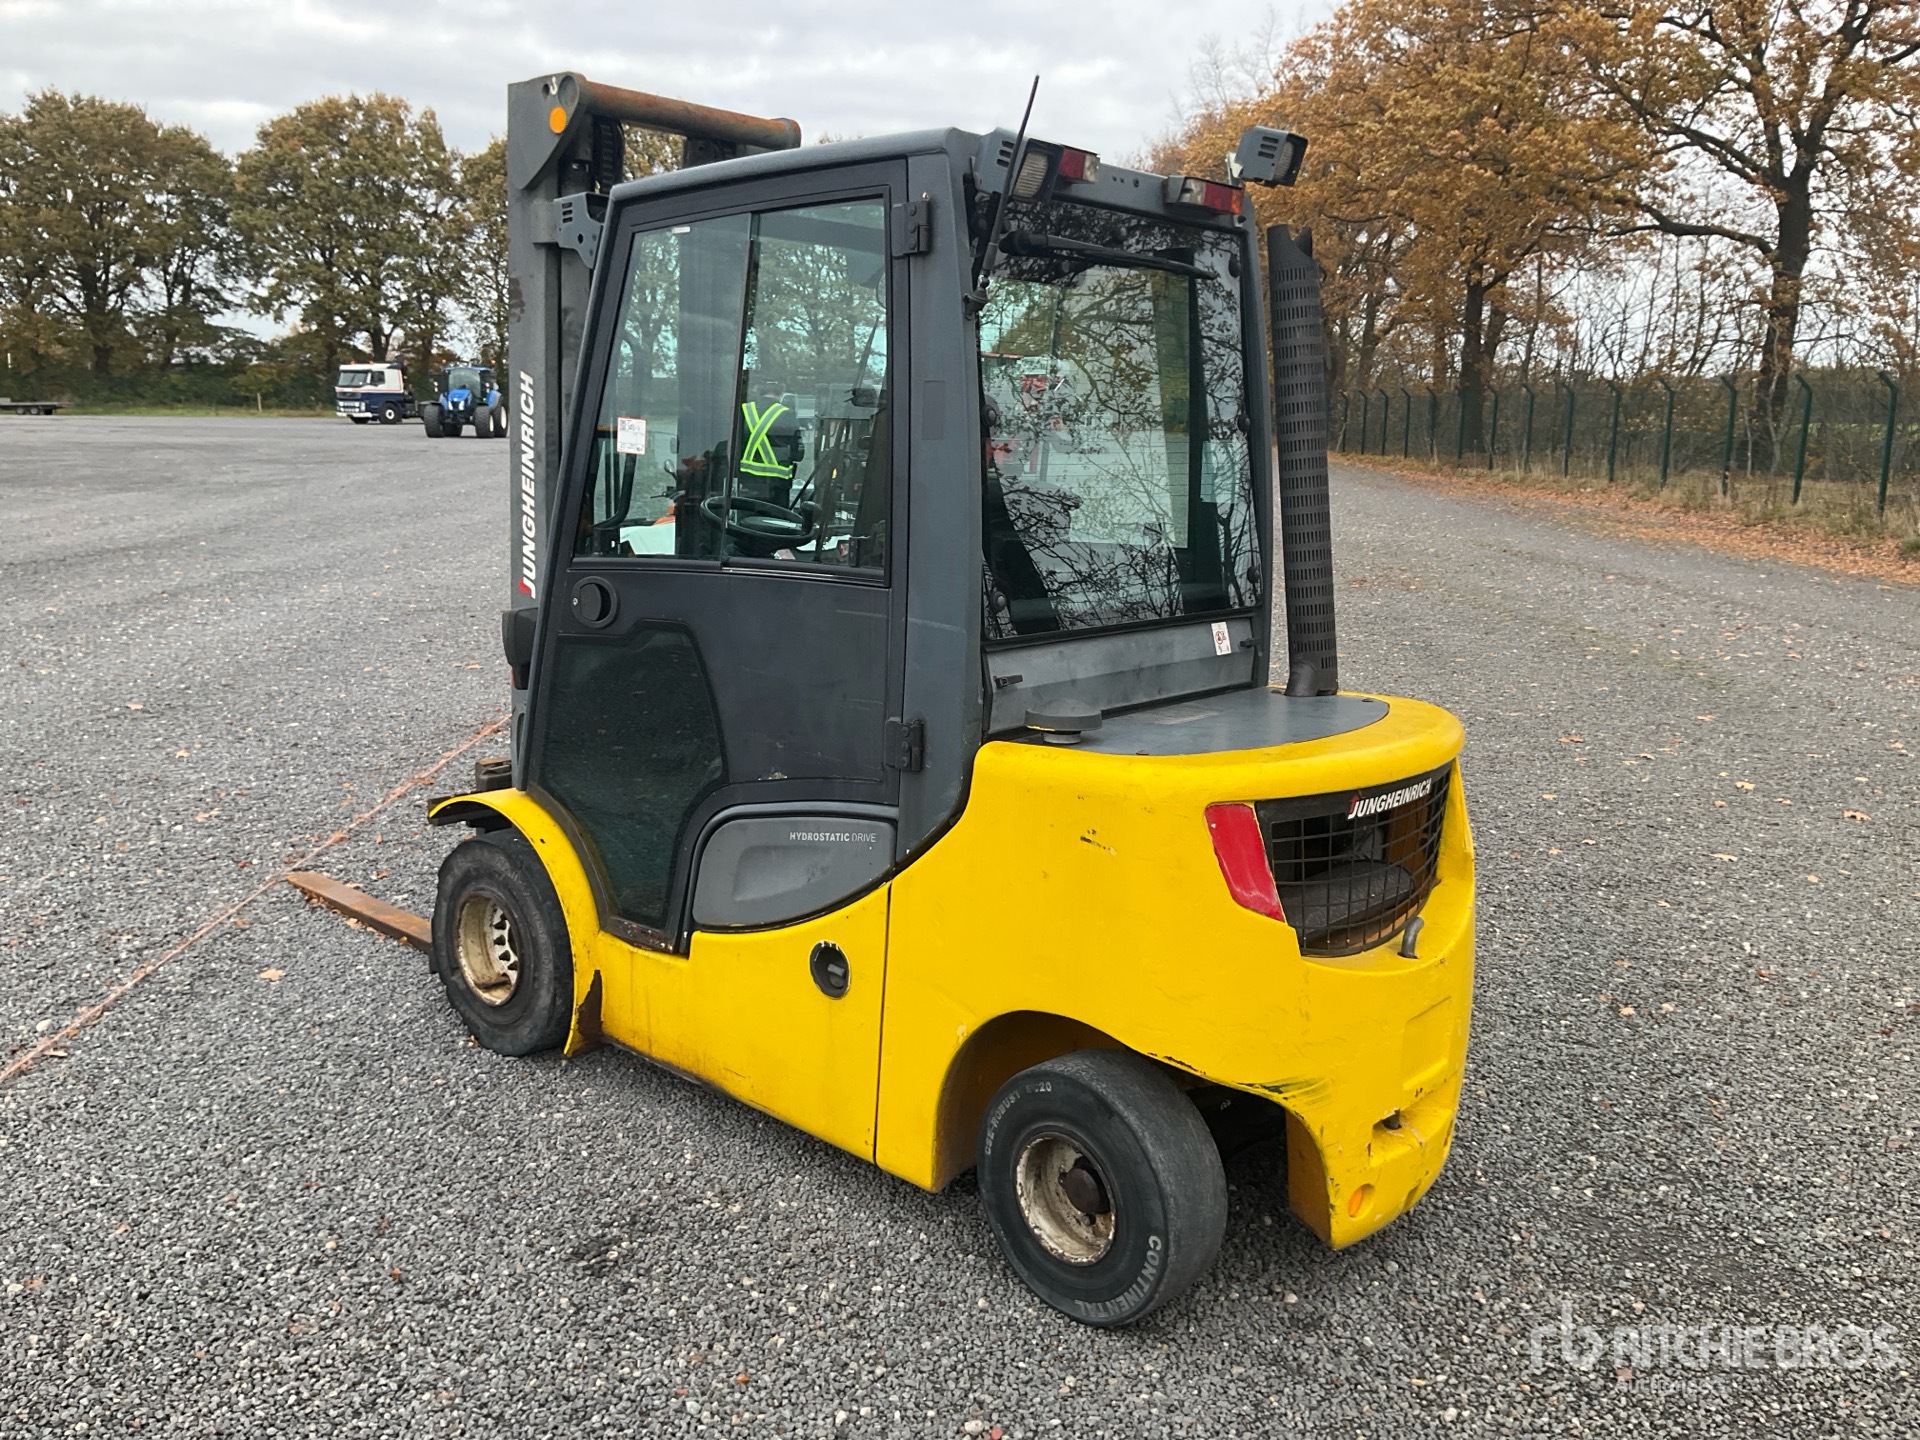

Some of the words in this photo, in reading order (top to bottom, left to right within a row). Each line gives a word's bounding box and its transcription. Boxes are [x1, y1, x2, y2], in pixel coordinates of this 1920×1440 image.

[519, 370, 536, 599] JUNGHEINRICH
[1347, 778, 1432, 819] JUNGHEINRICH
[789, 831, 850, 842] HYDROSTATIC
[851, 832, 877, 843] DRIVE
[1074, 1235, 1162, 1318] CONTINENTAL
